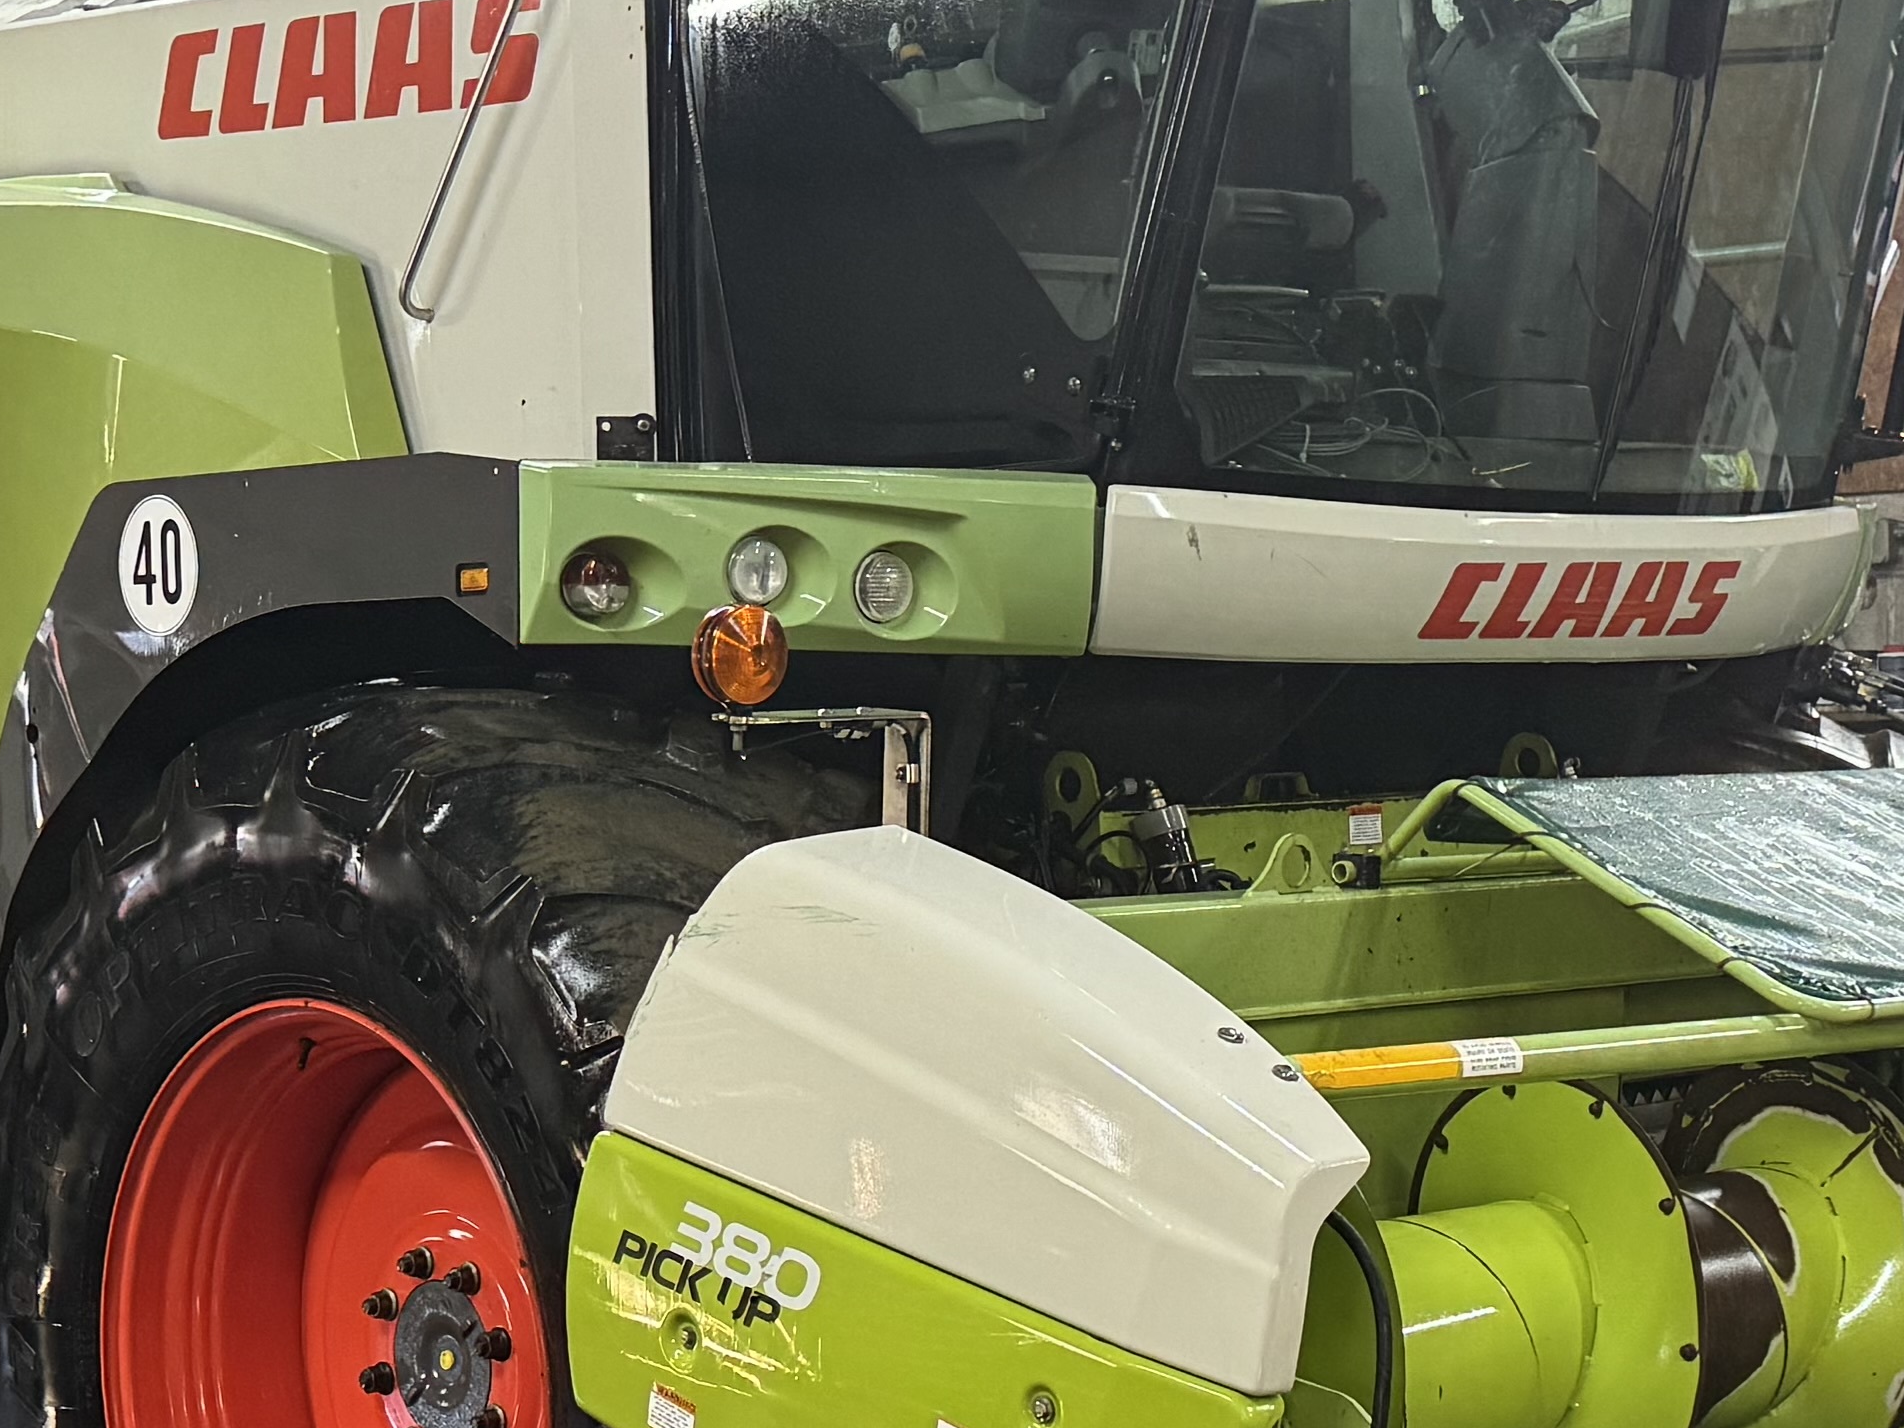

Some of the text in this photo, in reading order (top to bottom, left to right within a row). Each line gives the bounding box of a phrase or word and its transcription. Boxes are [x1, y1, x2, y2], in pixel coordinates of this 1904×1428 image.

[133, 518, 182, 606] 40
[1417, 560, 1742, 640] CLAAS
[612, 1229, 713, 1304] PICK
[669, 1200, 821, 1311] 380
